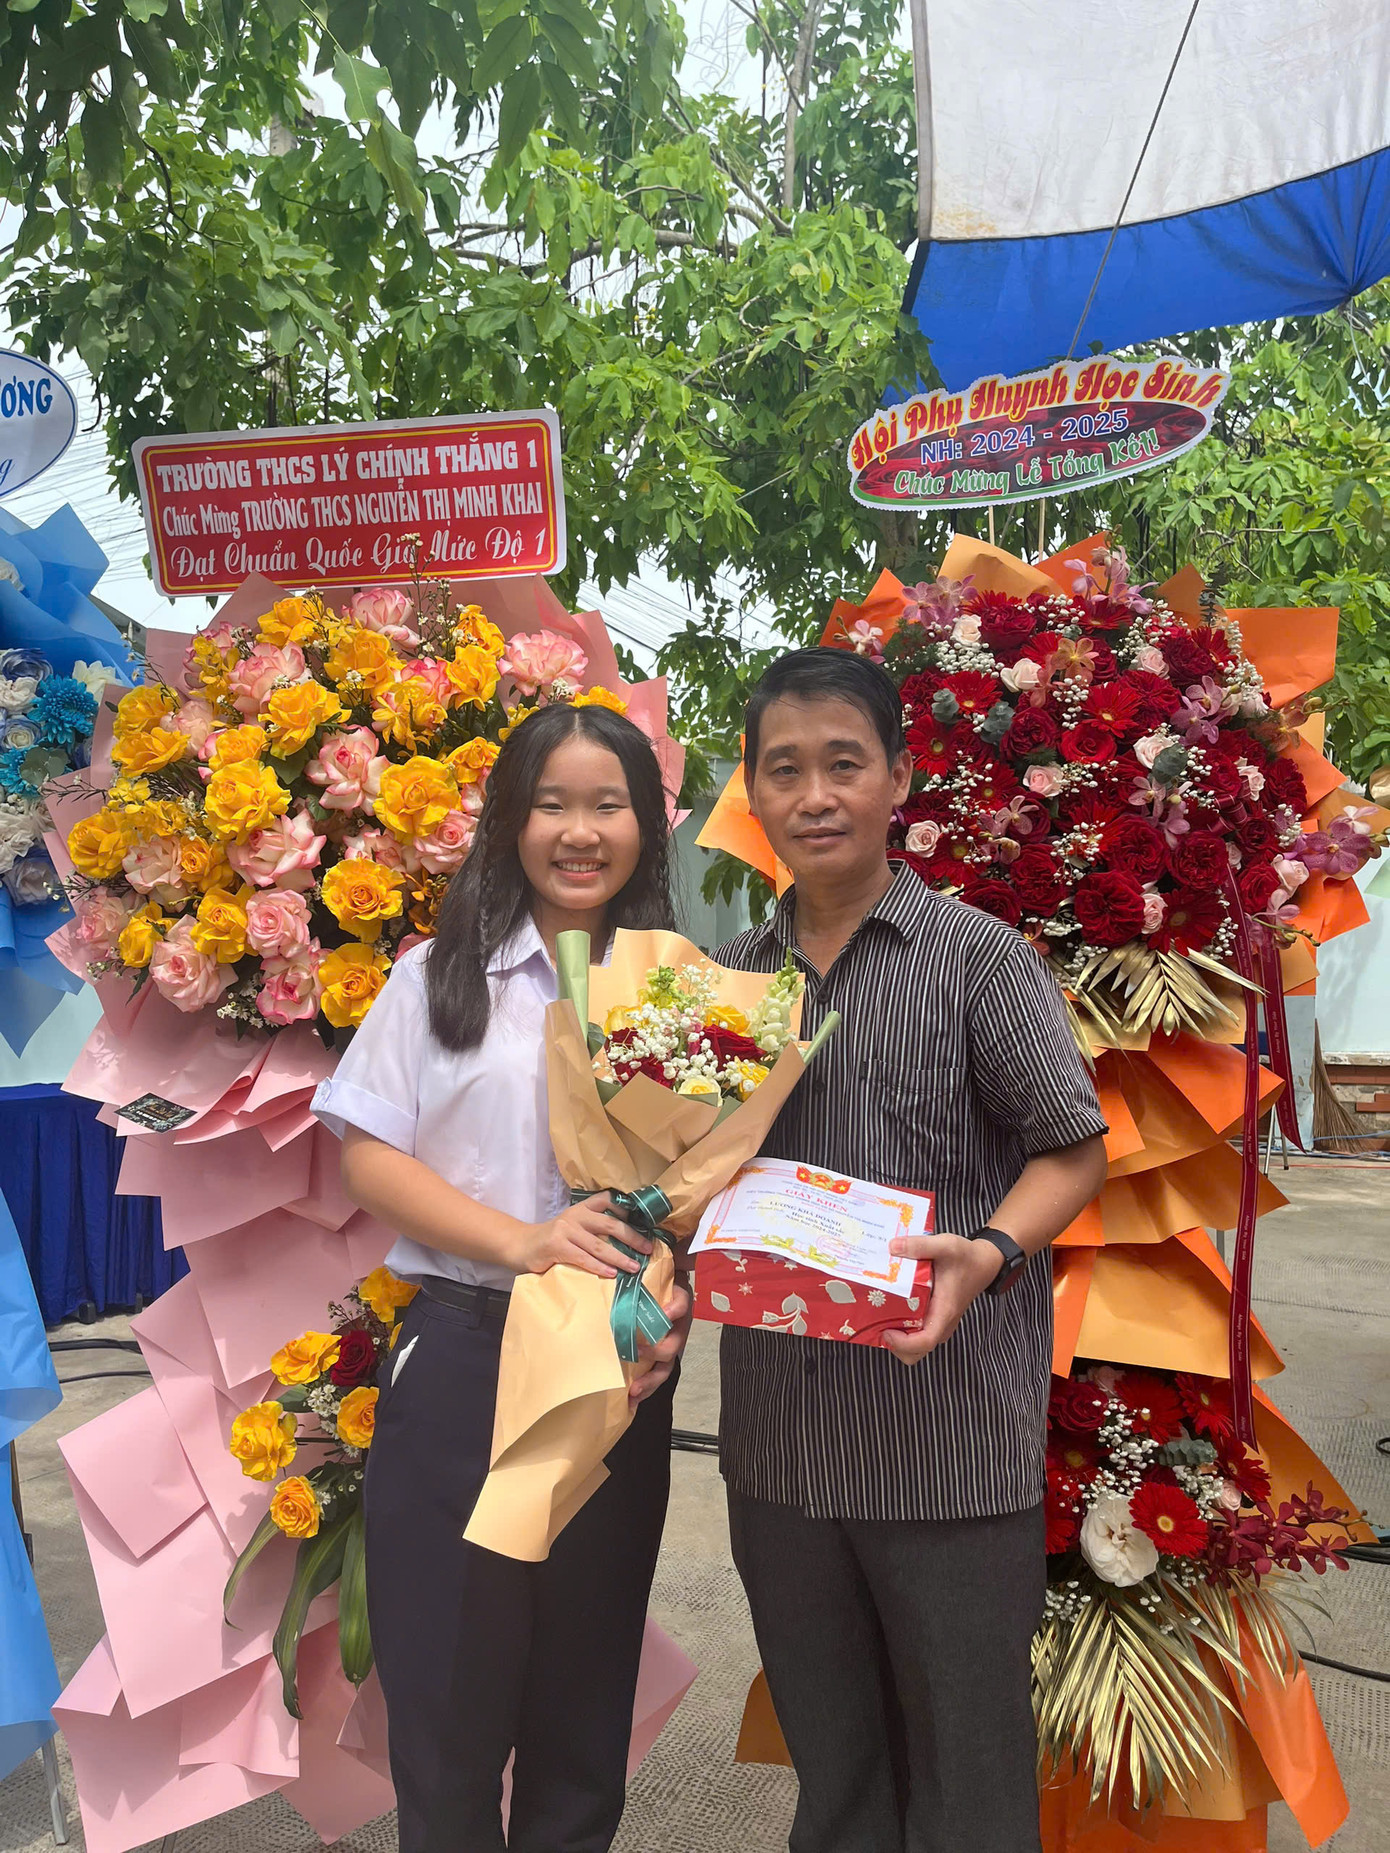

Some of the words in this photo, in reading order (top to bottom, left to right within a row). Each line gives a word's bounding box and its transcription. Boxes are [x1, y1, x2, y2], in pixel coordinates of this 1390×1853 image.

[0, 375, 53, 418] ƠNG
[850, 413, 898, 471] Hội
[904, 392, 963, 439] Phụ
[968, 364, 1070, 423] Huynh
[1074, 360, 1140, 412] Học
[1142, 360, 1224, 407] Sinh
[156, 456, 251, 493] TRƯỜNG
[256, 456, 316, 487] THCS
[322, 446, 350, 482] LÝ
[356, 445, 429, 480] CHÍNH
[435, 431, 518, 473] THẮNG
[526, 439, 538, 468] 1
[893, 467, 947, 495] Chúc
[950, 469, 1010, 496] Mừng
[1015, 457, 1042, 487] Lễ
[1047, 452, 1104, 480] Tổng
[1108, 427, 1160, 463] Kết!
[920, 438, 963, 465] NH:
[971, 424, 1035, 457] 2024
[1060, 409, 1129, 440] 2025
[163, 503, 199, 538] Chúc
[200, 502, 240, 540] Mừng
[241, 493, 309, 533] TRƯỜNG
[311, 495, 350, 529] THCS
[355, 475, 421, 524] NGUYỄN
[422, 488, 451, 526] THỊ
[455, 484, 499, 519] MINH
[501, 482, 543, 515] KHAI
[171, 545, 216, 579] Đạt
[224, 538, 299, 576] Chuẩn
[305, 536, 362, 577] Quốc
[485, 526, 525, 567] Độ
[535, 527, 547, 556] 1
